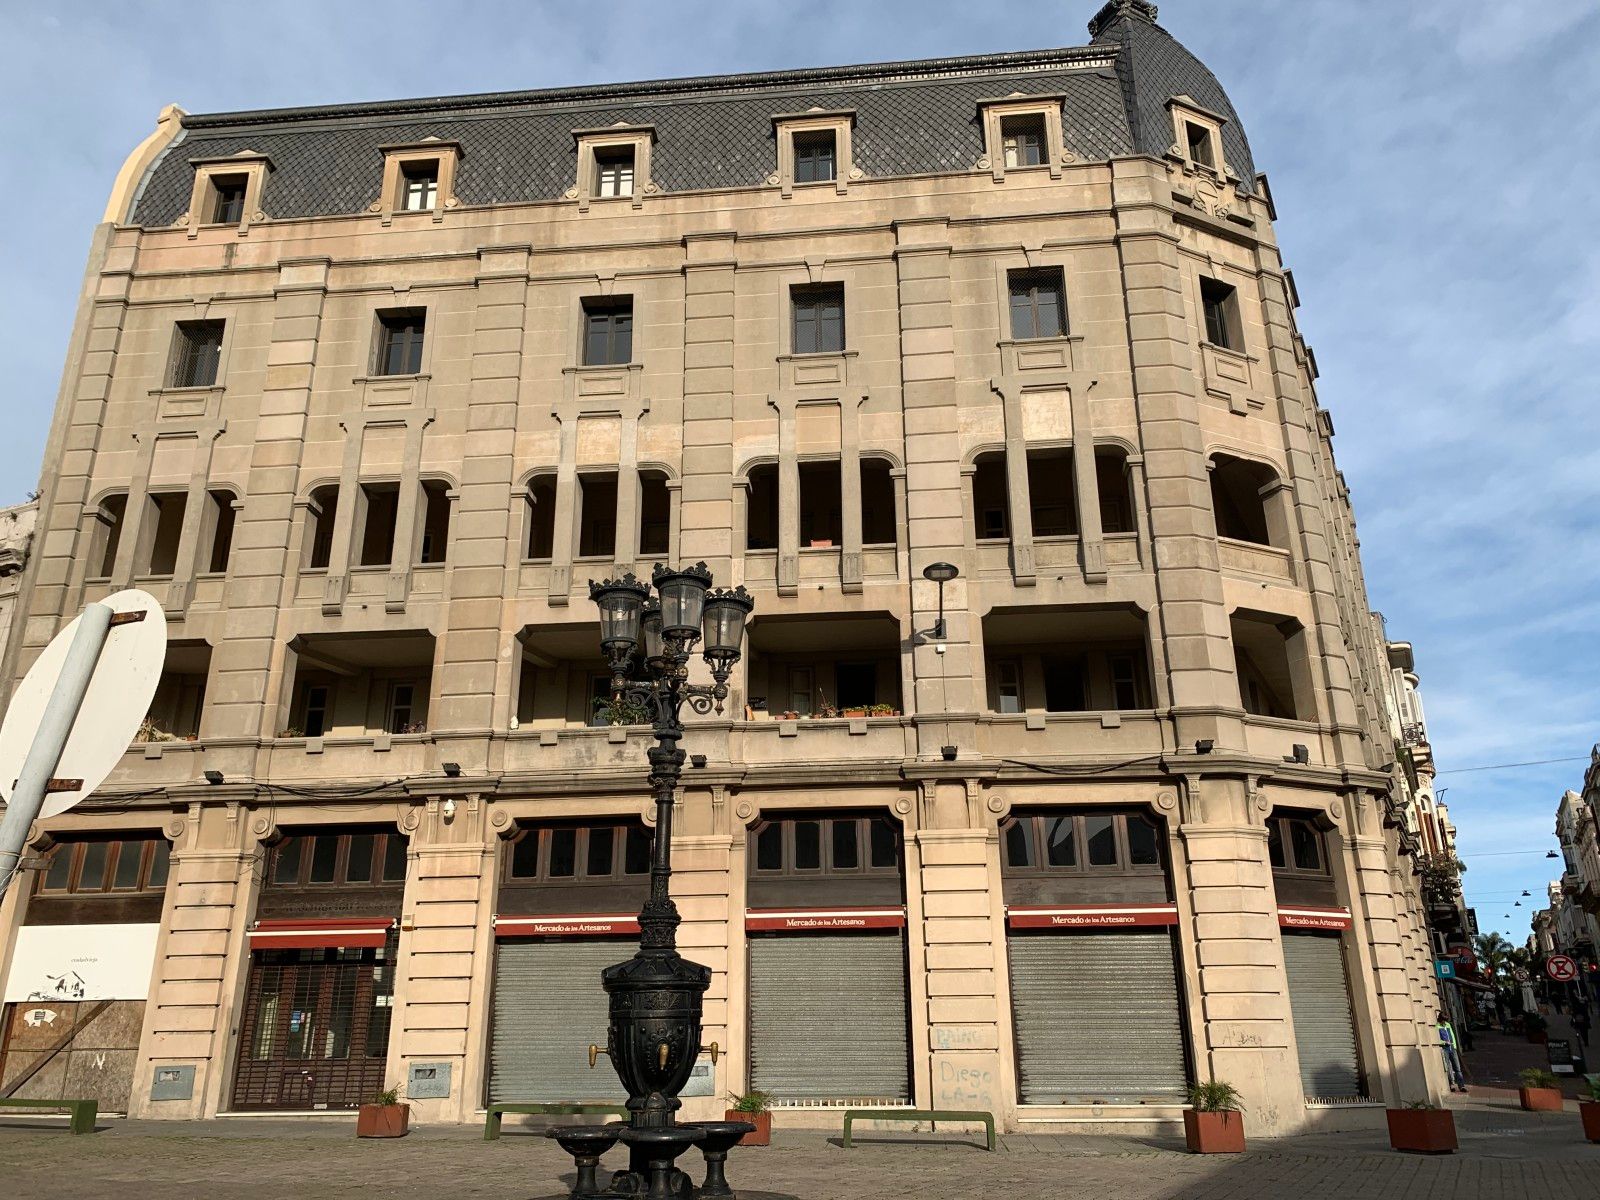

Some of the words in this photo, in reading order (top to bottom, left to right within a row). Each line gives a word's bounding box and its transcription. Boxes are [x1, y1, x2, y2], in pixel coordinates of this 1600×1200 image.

[786, 919, 817, 927] Mercado
[832, 918, 866, 926] Artesanos
[1052, 916, 1084, 924] Mercado
[1285, 916, 1309, 925] Mercado
[1320, 919, 1345, 927] Artesanos
[534, 924, 564, 932] Mercado
[579, 924, 612, 932] Artesanos
[941, 1061, 992, 1088] Diego
